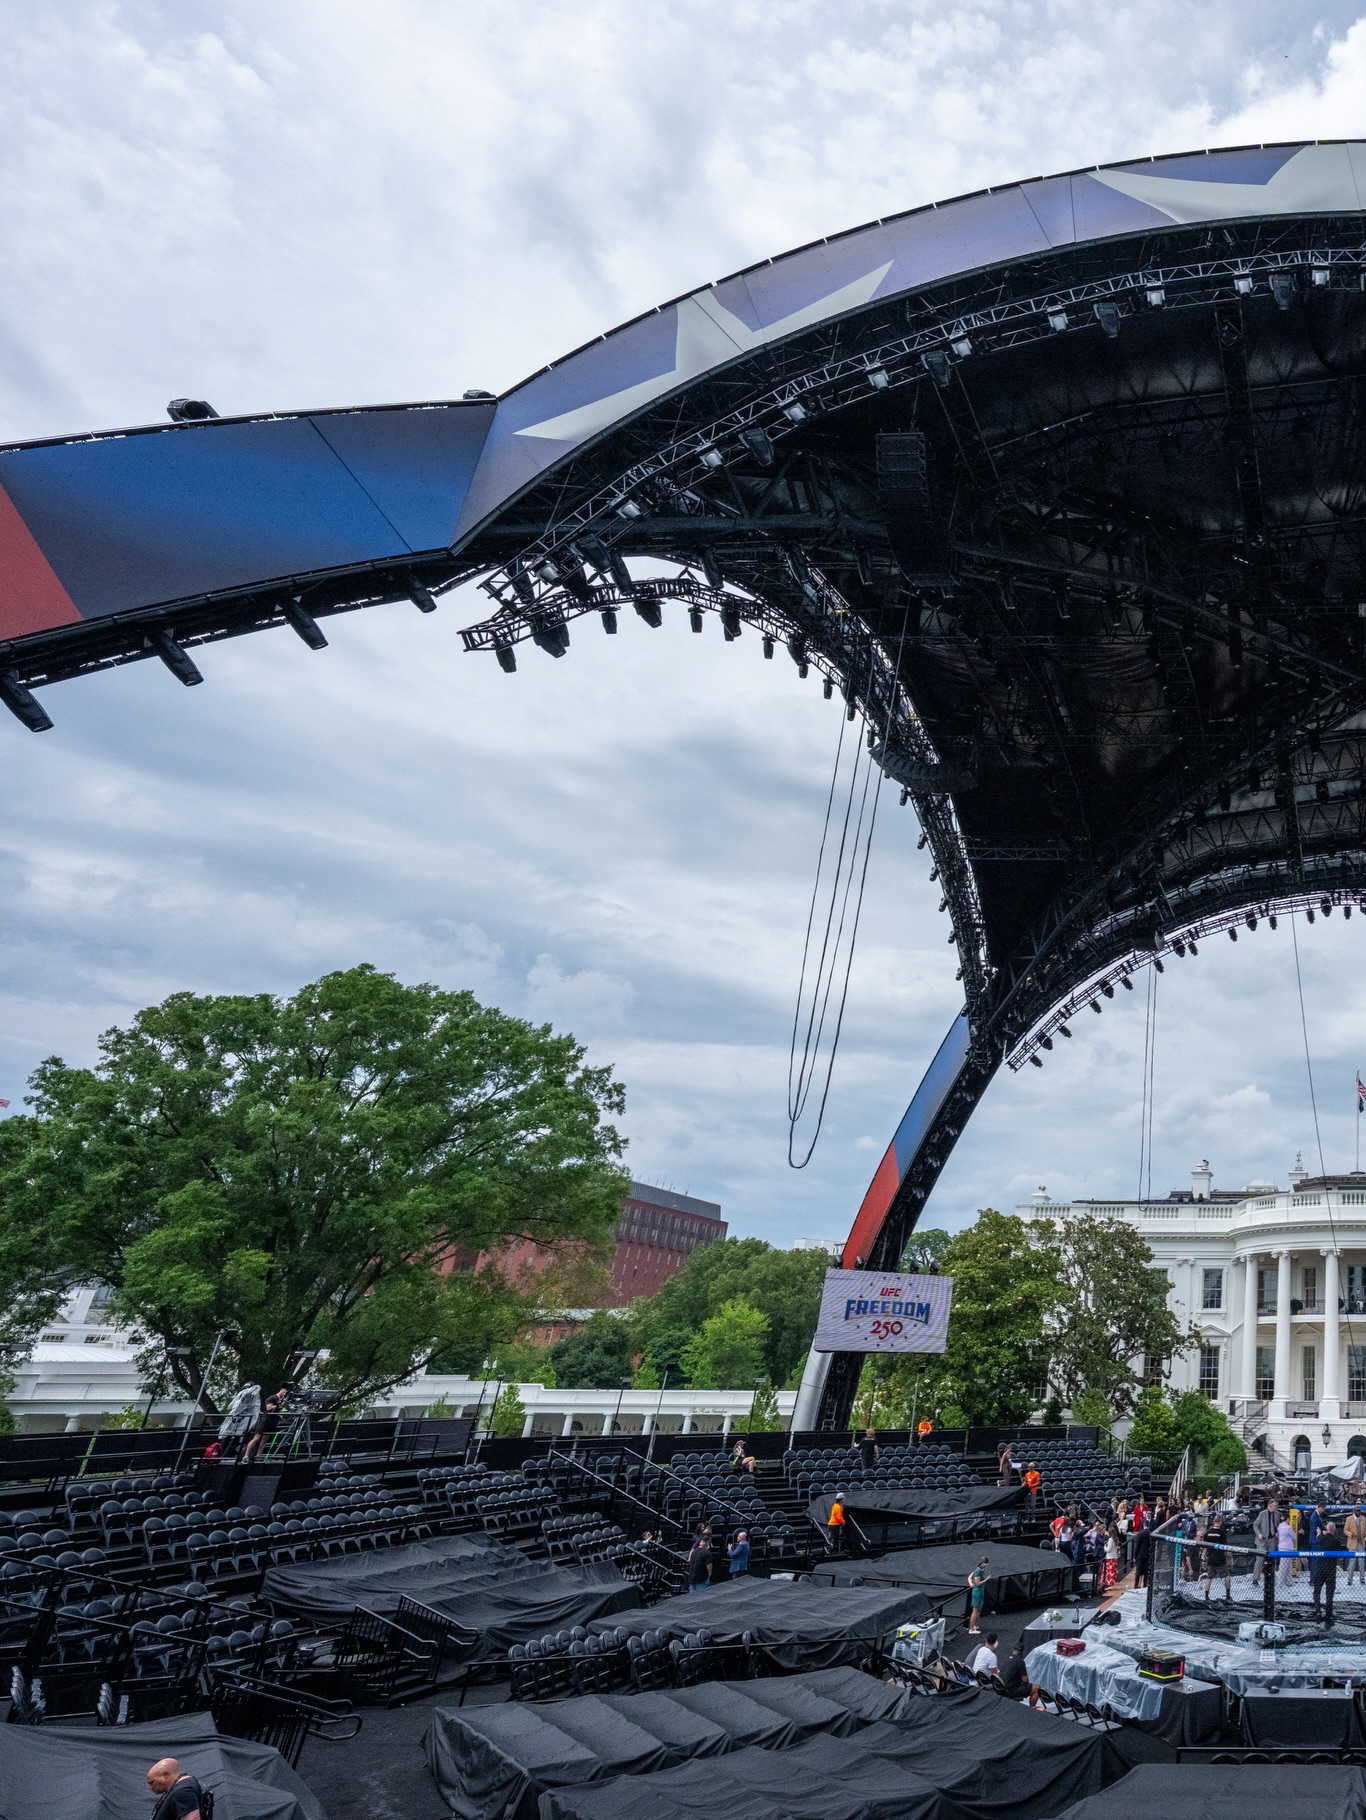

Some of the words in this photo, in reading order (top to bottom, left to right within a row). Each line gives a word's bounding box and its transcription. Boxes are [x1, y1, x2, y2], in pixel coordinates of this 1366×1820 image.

[880, 1287, 901, 1297] UFC
[844, 1299, 931, 1325] FREEDOM
[870, 1320, 904, 1340] 250
